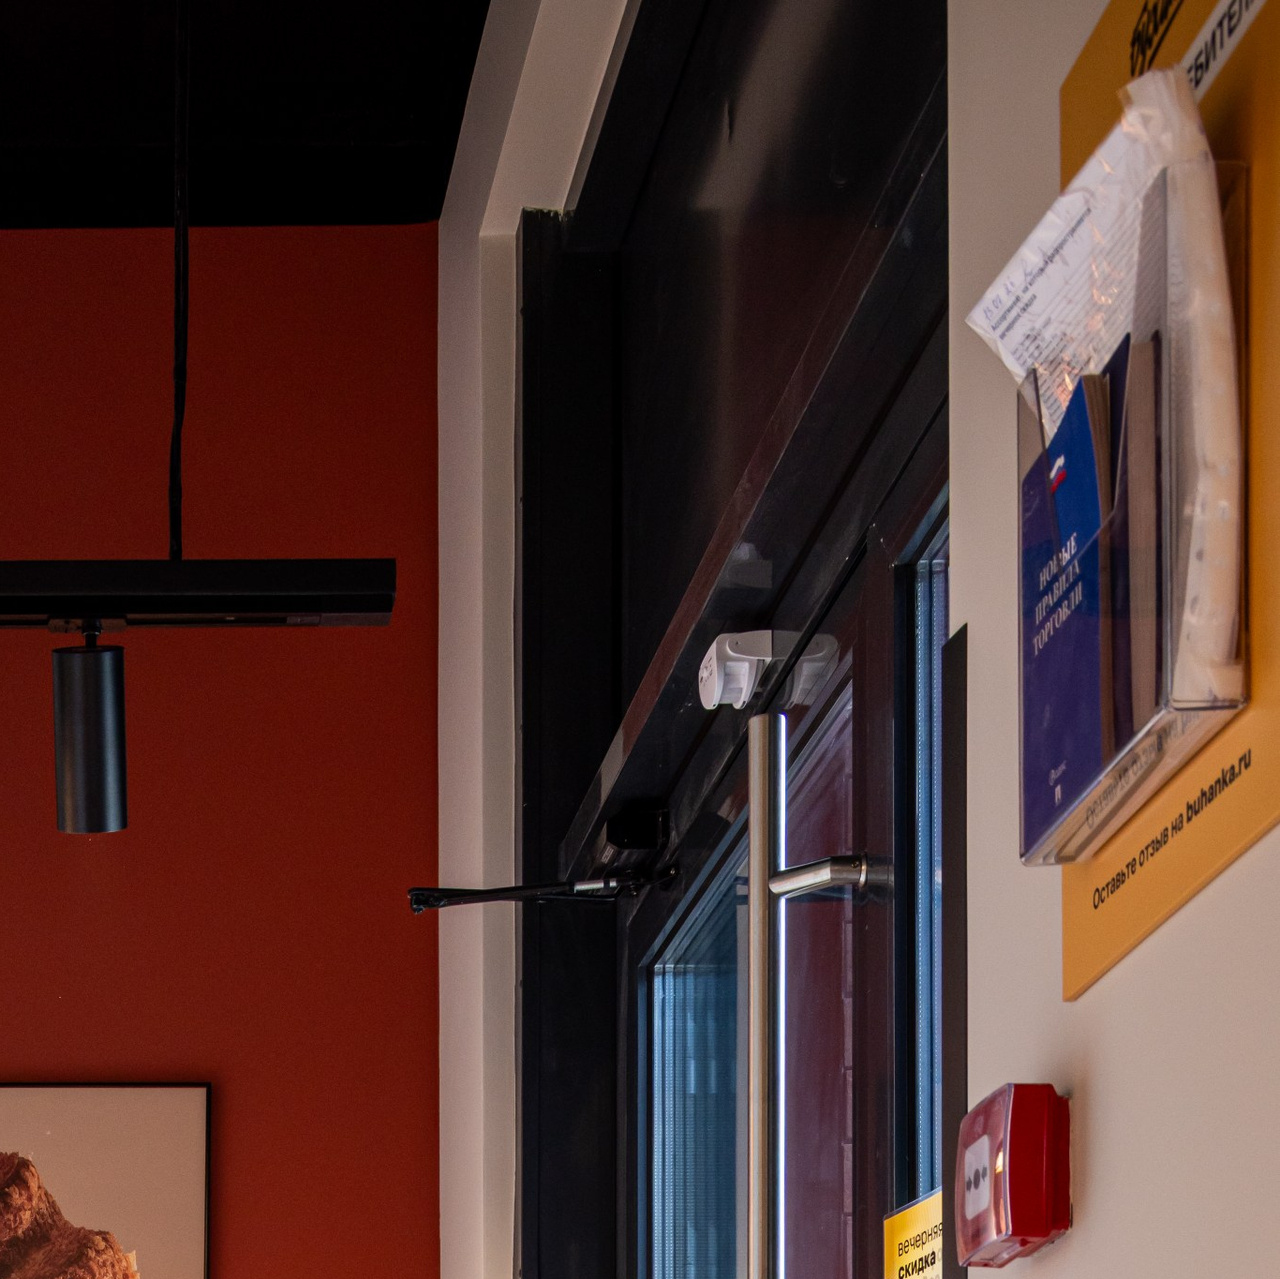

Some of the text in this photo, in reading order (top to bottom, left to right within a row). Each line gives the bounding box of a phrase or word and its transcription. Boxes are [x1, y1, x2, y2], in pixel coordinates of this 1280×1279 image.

[1033, 580, 1082, 656] ТОРГОВЛИ
[1092, 748, 1252, 910] Оставьте отзыв на buhanka.ru
[898, 1221, 943, 1258] вечерняя
